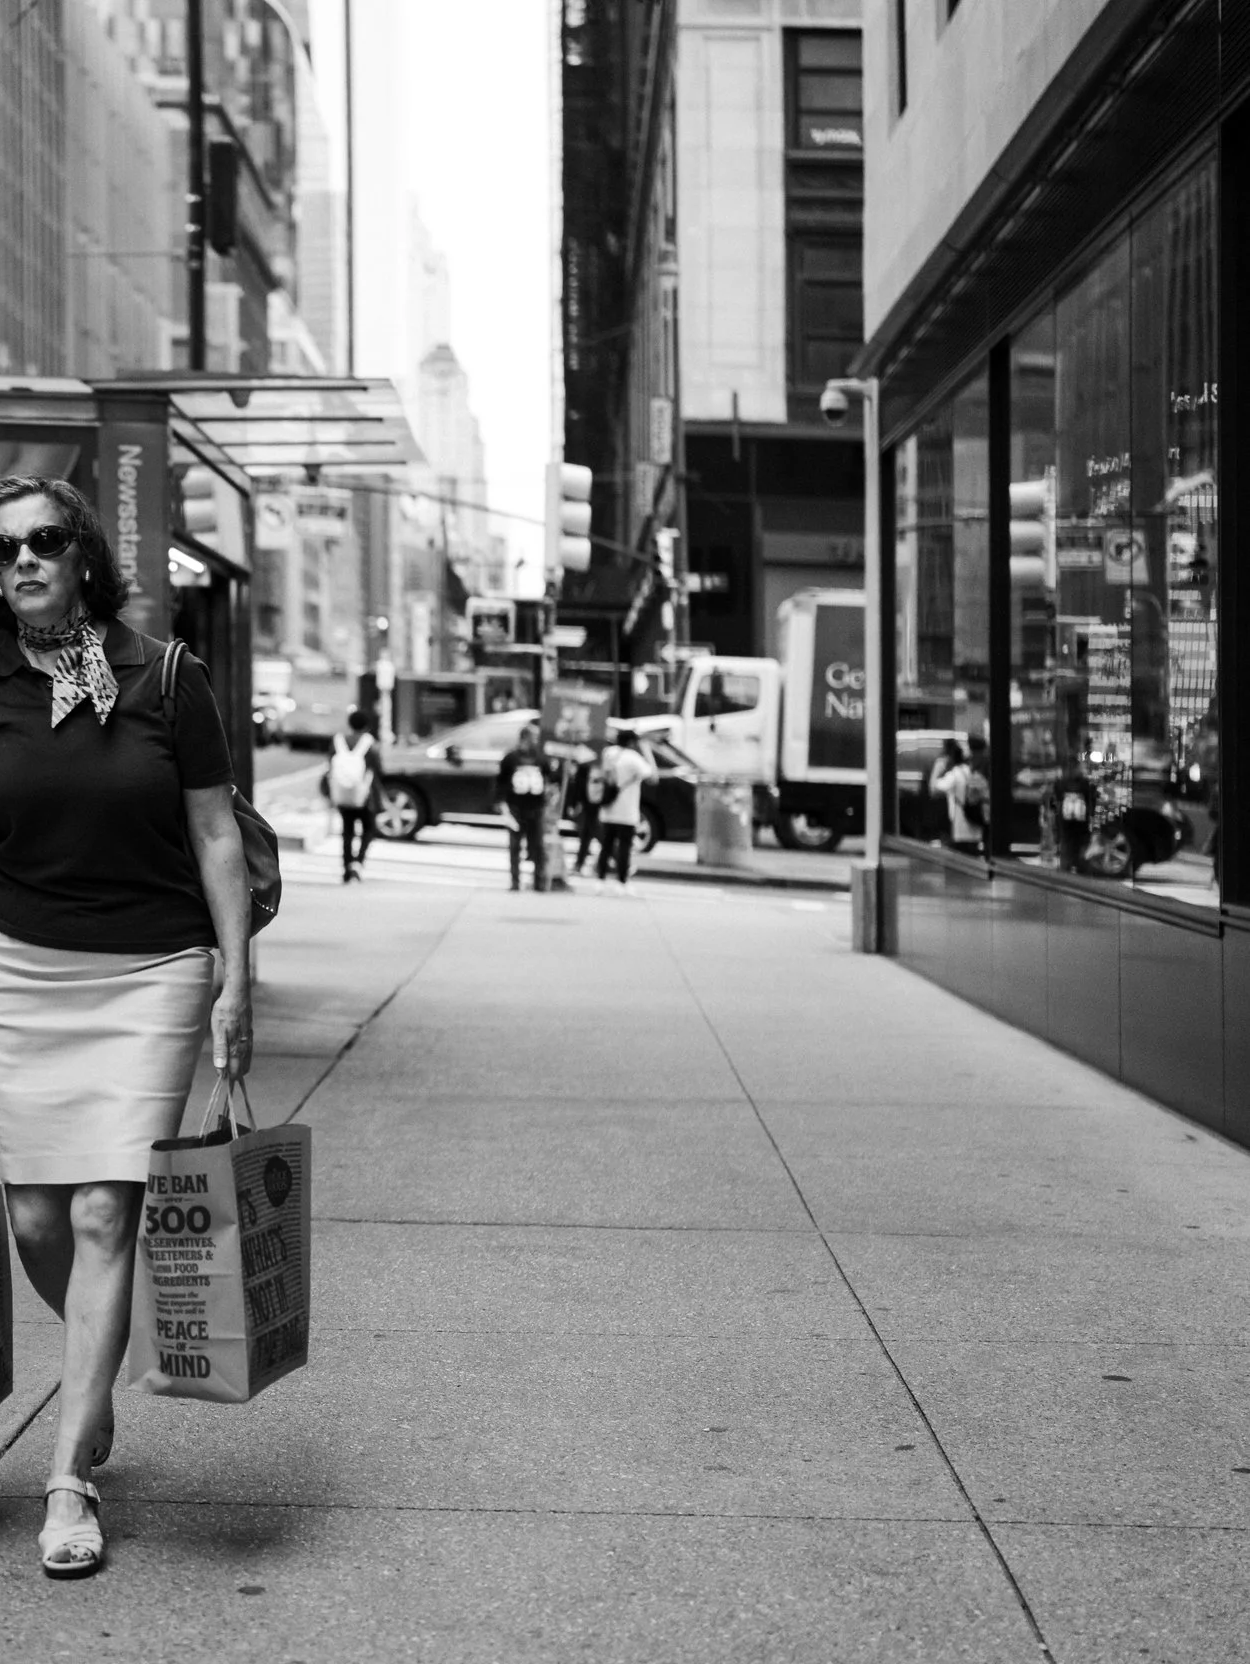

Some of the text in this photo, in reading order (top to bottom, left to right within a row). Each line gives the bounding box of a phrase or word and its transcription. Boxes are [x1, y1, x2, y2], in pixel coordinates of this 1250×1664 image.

[171, 1173, 209, 1194] BAN
[145, 1205, 211, 1235] 300
[205, 1250, 214, 1260] &
[174, 1263, 199, 1273] FOOD
[156, 1318, 209, 1340] PEACE
[159, 1351, 211, 1378] MIND
